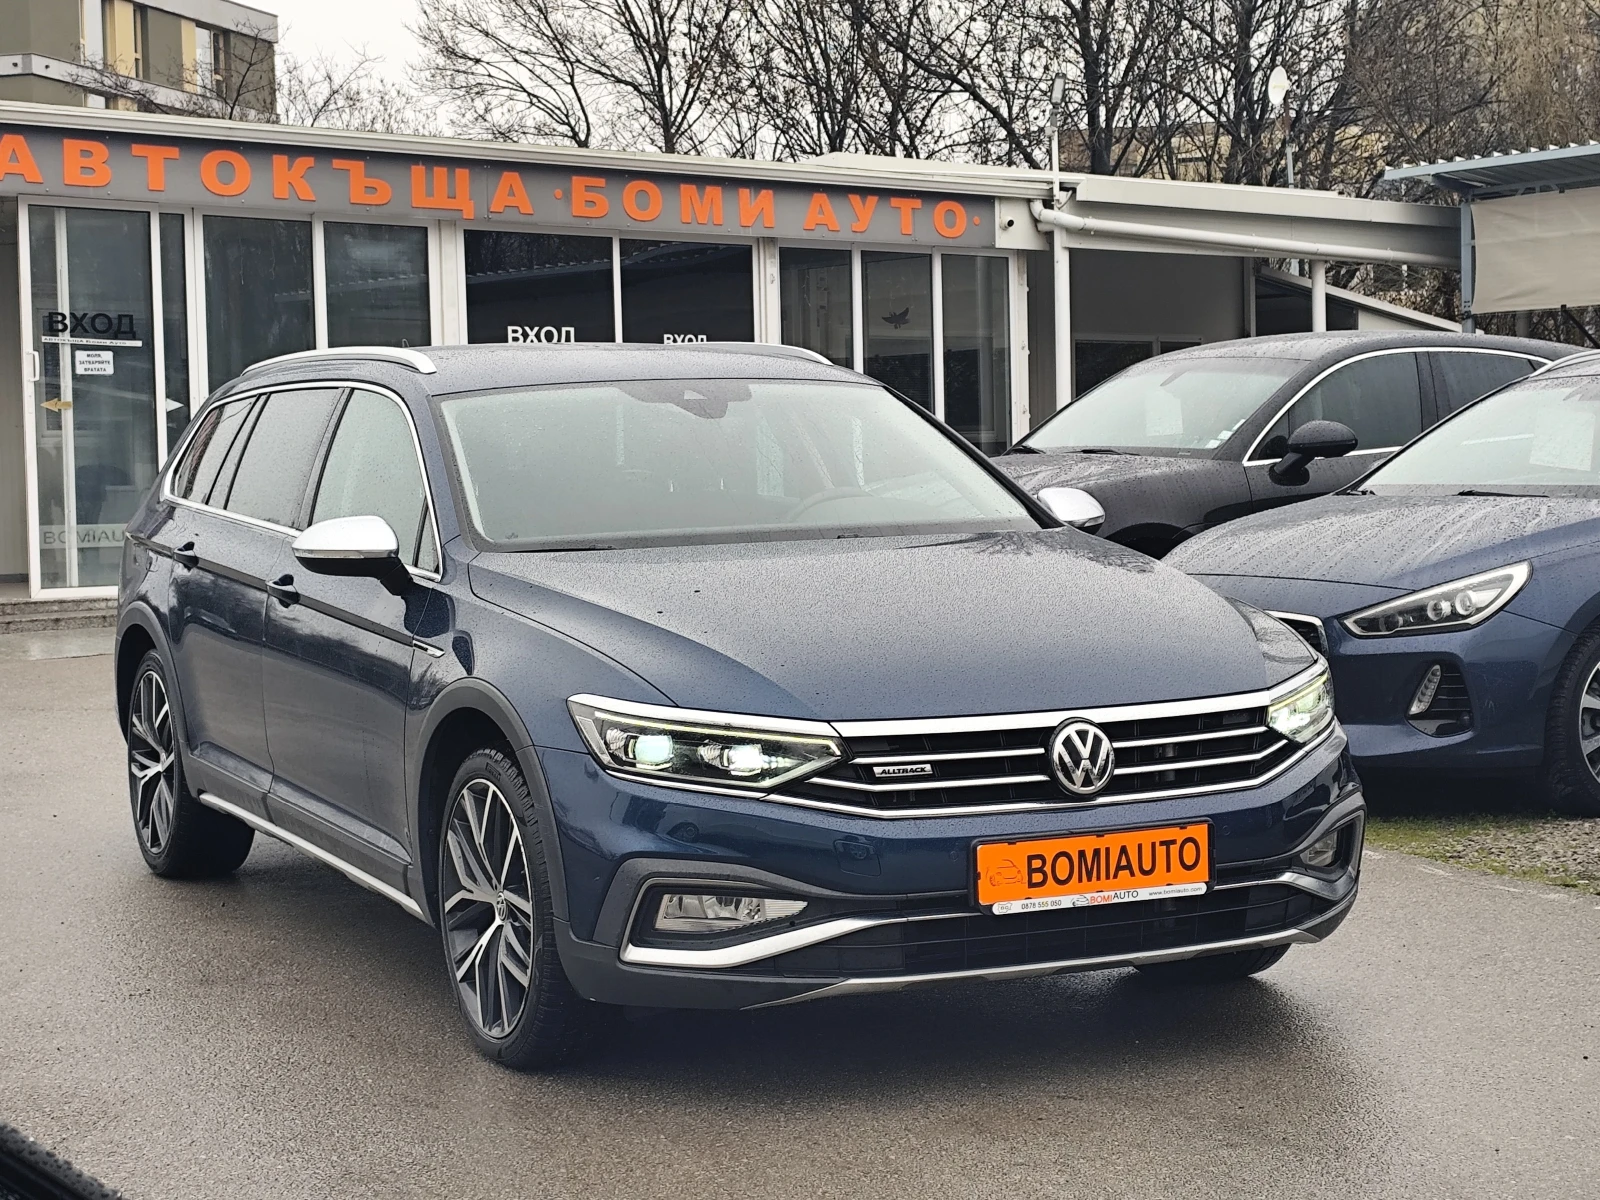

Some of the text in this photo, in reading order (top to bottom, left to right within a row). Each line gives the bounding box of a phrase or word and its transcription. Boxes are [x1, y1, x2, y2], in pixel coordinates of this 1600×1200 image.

[0, 134, 966, 239] АВТОКЪЩА БОМИ АУТО
[48, 311, 136, 339] ВХОД
[507, 325, 576, 344] ВХОД
[880, 766, 927, 775] ALLTRACK
[1026, 836, 1201, 889] BOMIAUTO
[1021, 902, 1037, 910] 0878
[1050, 899, 1062, 907] 050
[1090, 890, 1139, 905] BOMIAUTO
[1148, 886, 1203, 897] www.bomiauto.com
